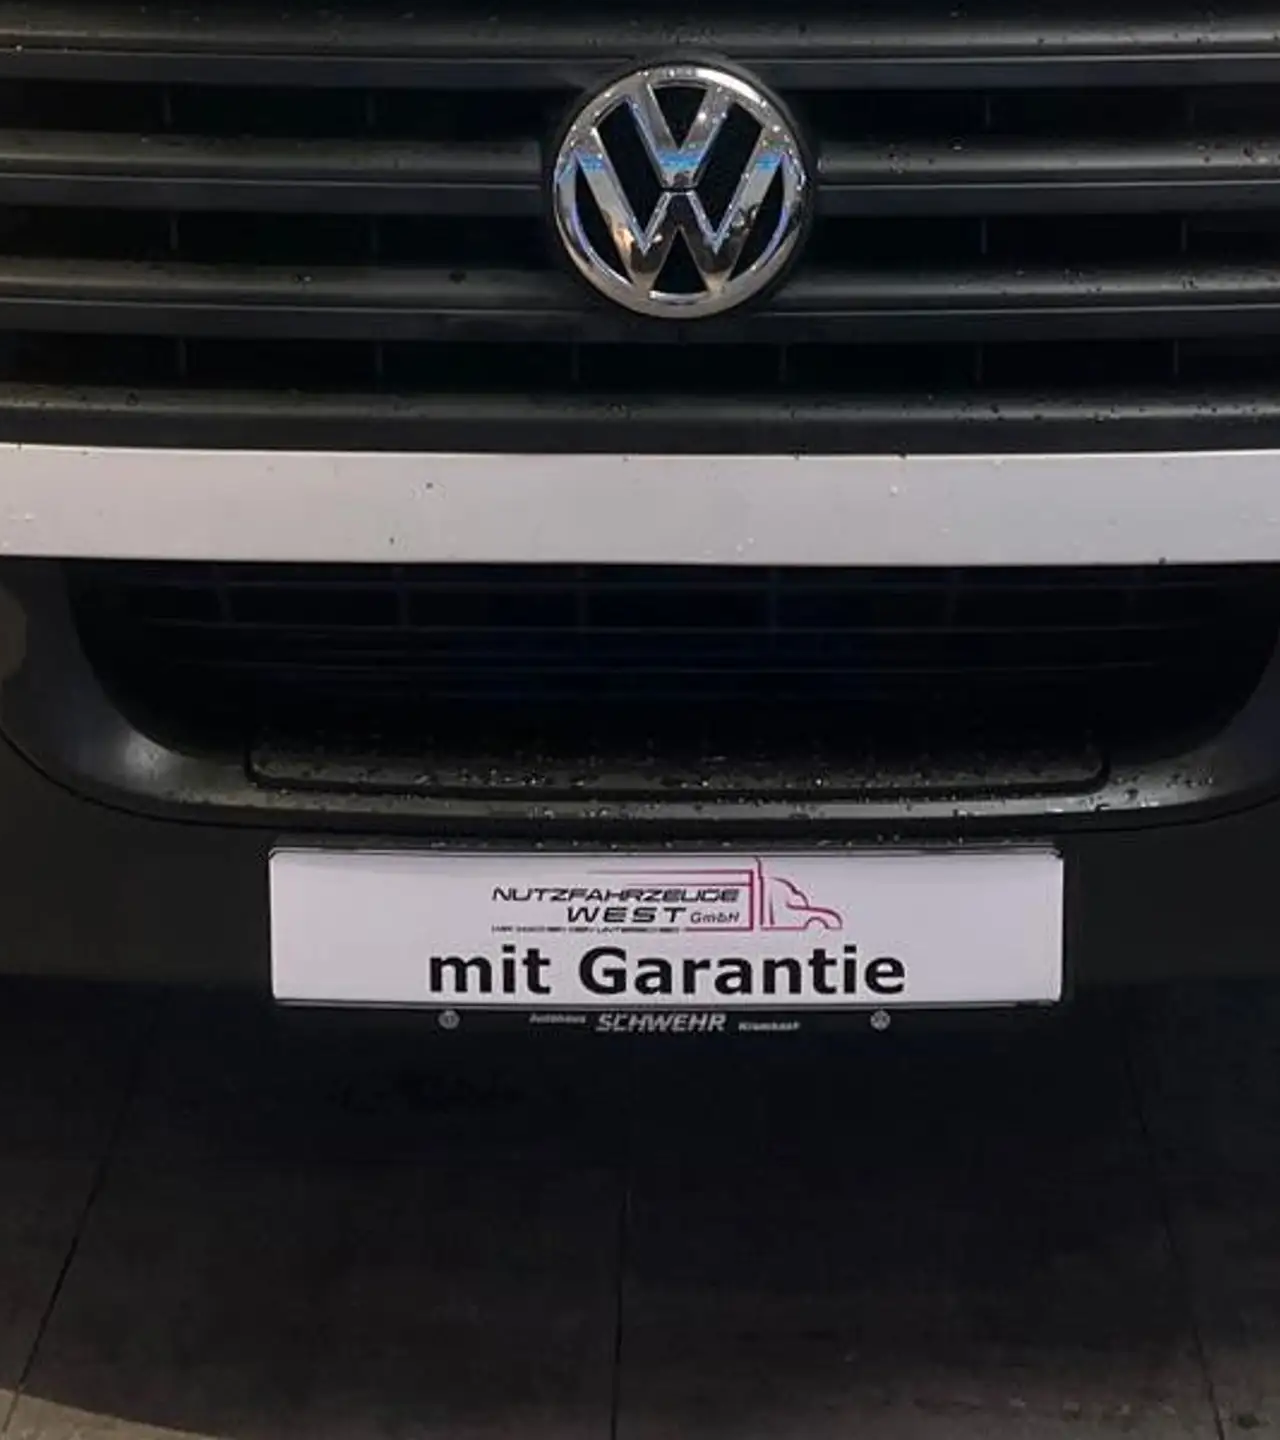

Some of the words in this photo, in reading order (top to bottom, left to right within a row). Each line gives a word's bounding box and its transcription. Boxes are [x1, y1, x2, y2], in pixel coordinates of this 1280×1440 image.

[491, 887, 740, 903] NUTZFAHRZEUGE
[567, 906, 687, 923] WEST
[690, 911, 740, 924] GmbH
[429, 944, 552, 995] mit
[578, 945, 906, 995] Garantie
[595, 1013, 727, 1033] SCHWEHR
